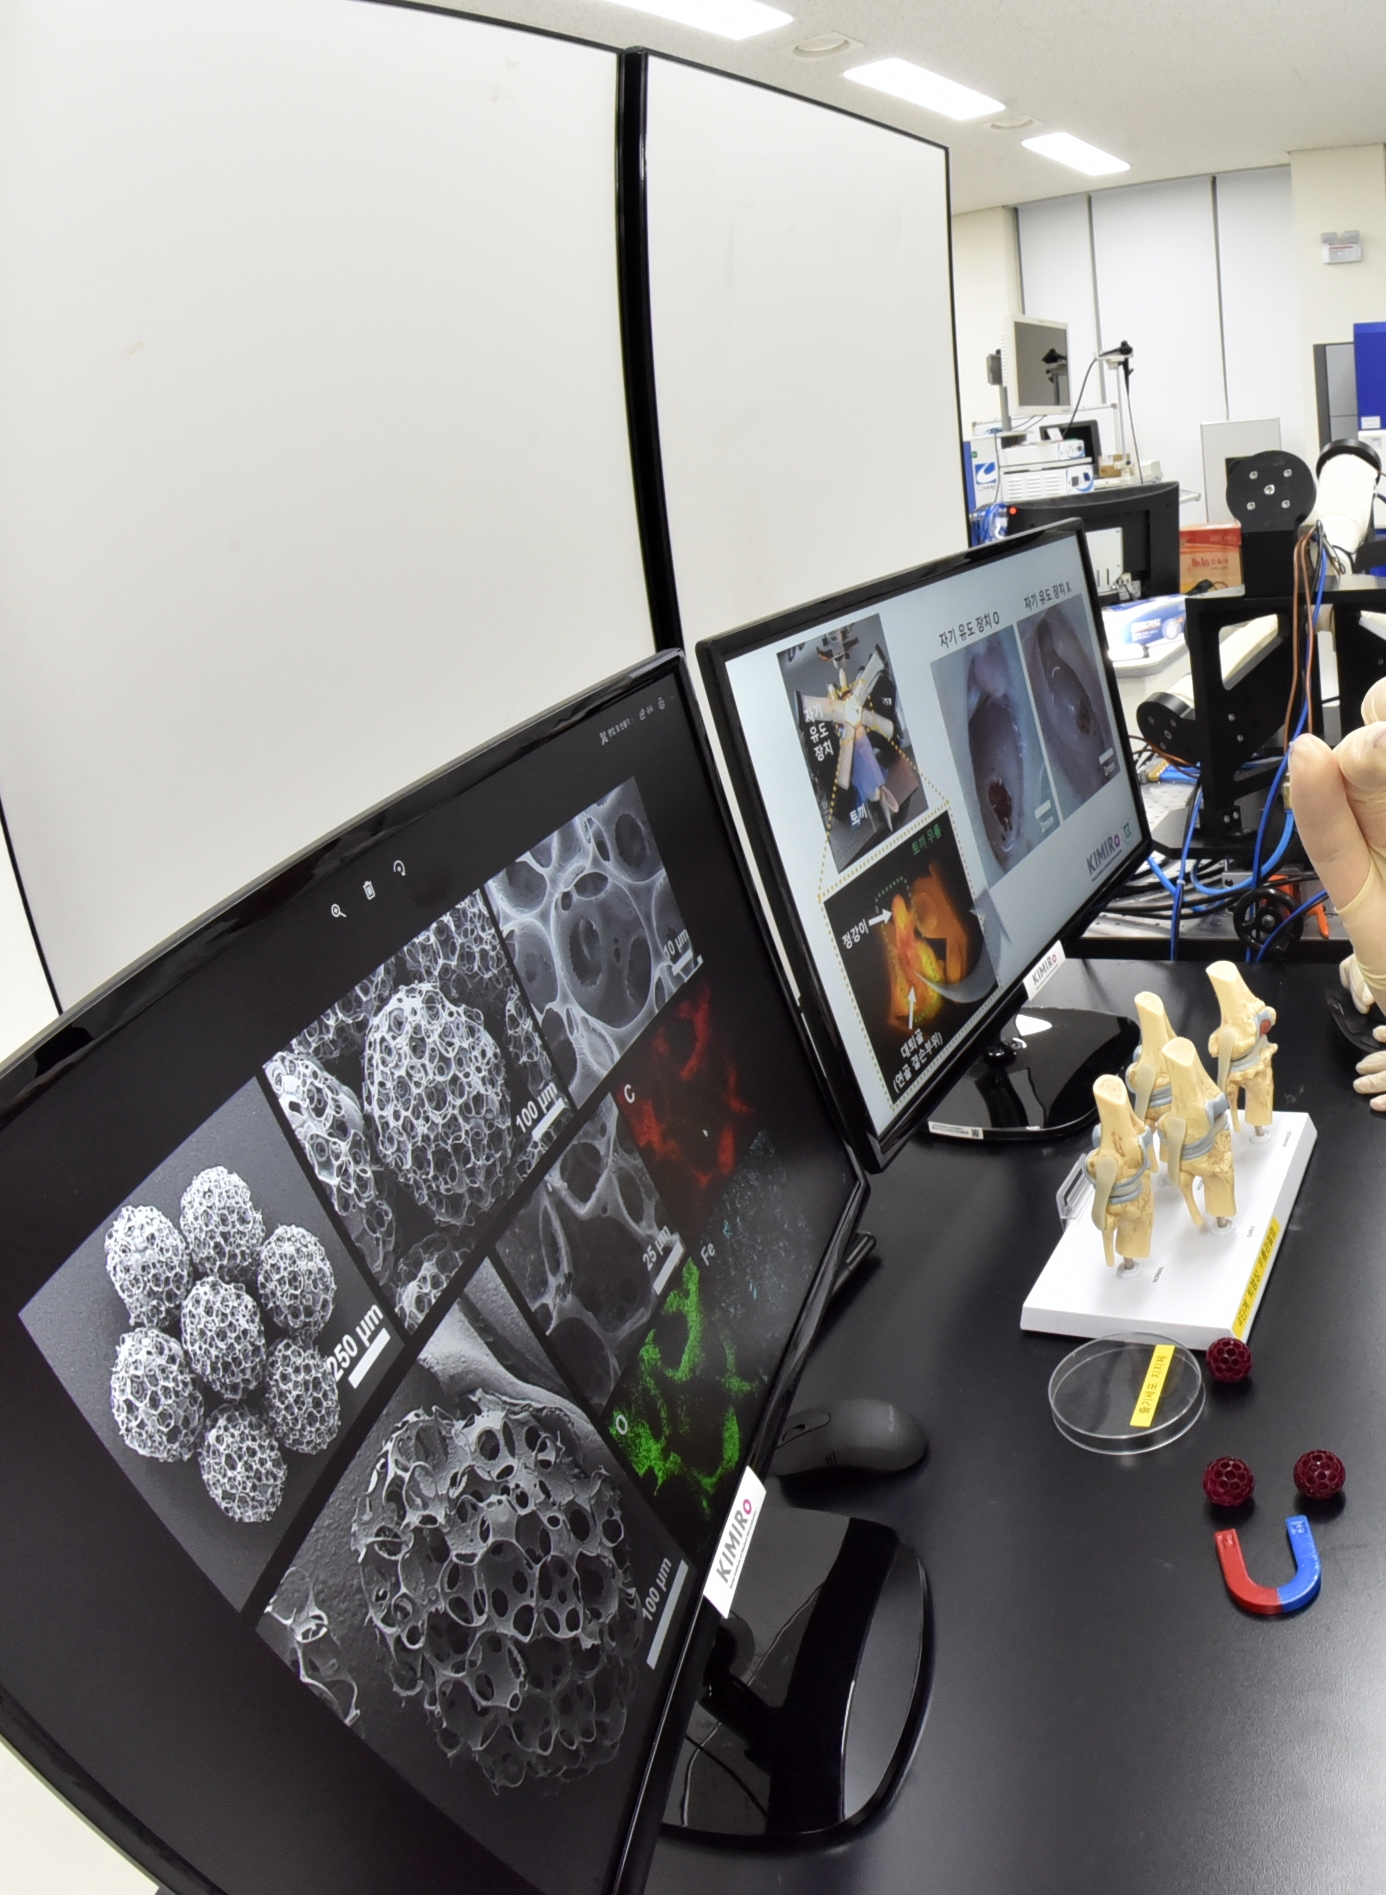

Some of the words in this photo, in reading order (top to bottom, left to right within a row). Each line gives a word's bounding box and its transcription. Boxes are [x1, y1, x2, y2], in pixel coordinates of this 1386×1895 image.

[1024, 593, 1038, 610] 자기
[1039, 589, 1052, 605] 유도
[1052, 582, 1066, 598] 장치
[1066, 581, 1072, 593] X
[939, 628, 957, 648] 자기
[958, 621, 976, 641] 유도
[975, 612, 992, 633] 장치
[804, 702, 823, 722] 자기
[810, 722, 829, 743] 유도
[814, 739, 834, 761] 장치
[850, 803, 867, 826] 토끼
[911, 834, 928, 855] 토끼
[842, 918, 869, 949] 정강이
[900, 1028, 924, 1058] 대퇴골
[624, 1084, 635, 1103] C
[516, 1100, 538, 1133] 100
[643, 1244, 657, 1271] 25
[700, 1243, 716, 1266] Fe
[1238, 1298, 1250, 1327] 4단계
[326, 1334, 358, 1382] 250
[1138, 1382, 1158, 1414] 줄기세포
[1151, 1355, 1168, 1378] 지지체
[642, 1587, 660, 1621] 100
